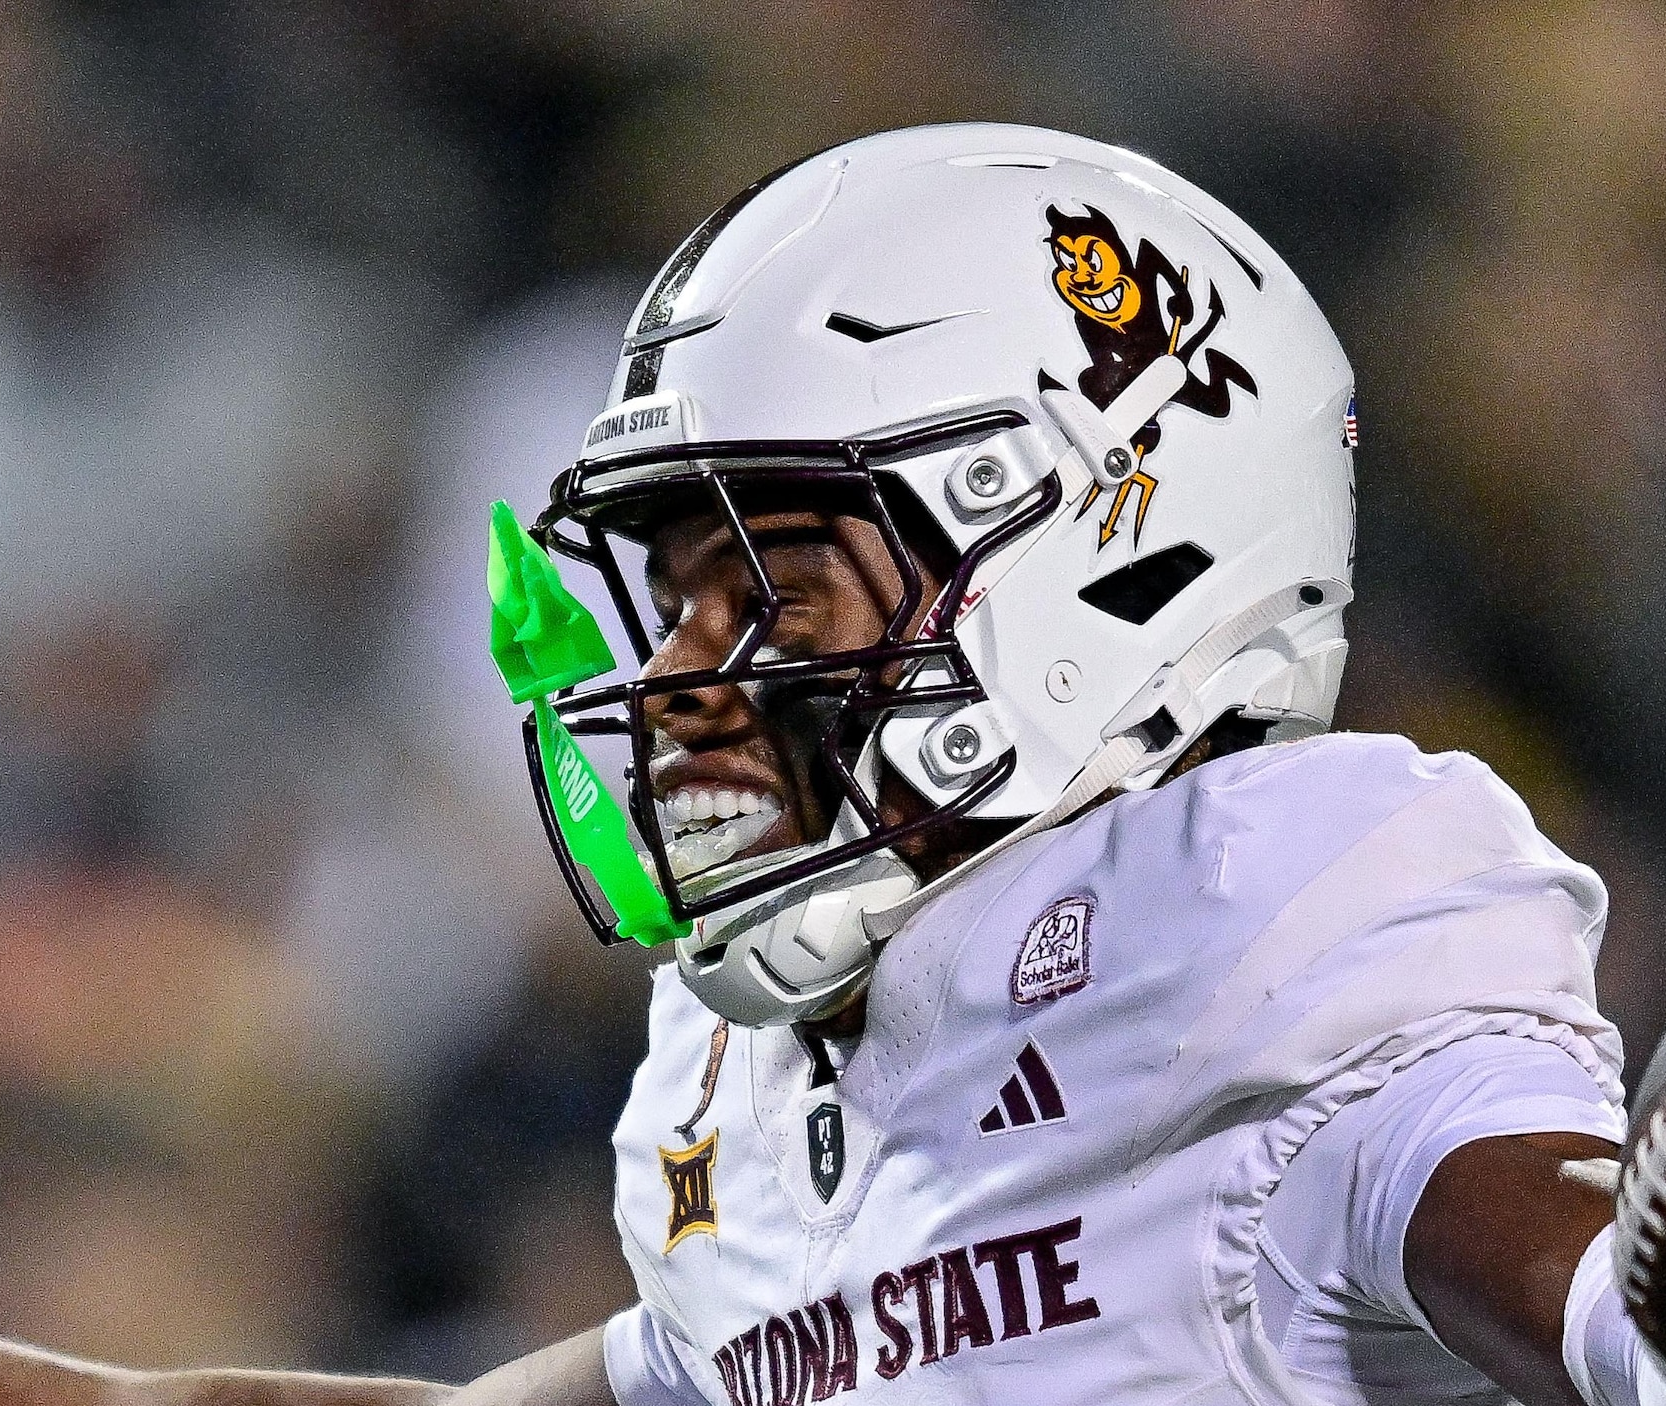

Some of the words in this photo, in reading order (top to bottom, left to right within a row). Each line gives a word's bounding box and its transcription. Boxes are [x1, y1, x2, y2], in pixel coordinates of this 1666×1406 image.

[629, 405, 672, 433] STATE
[817, 1116, 832, 1142] PT
[820, 1151, 835, 1175] 42
[870, 1215, 1101, 1380] STATE
